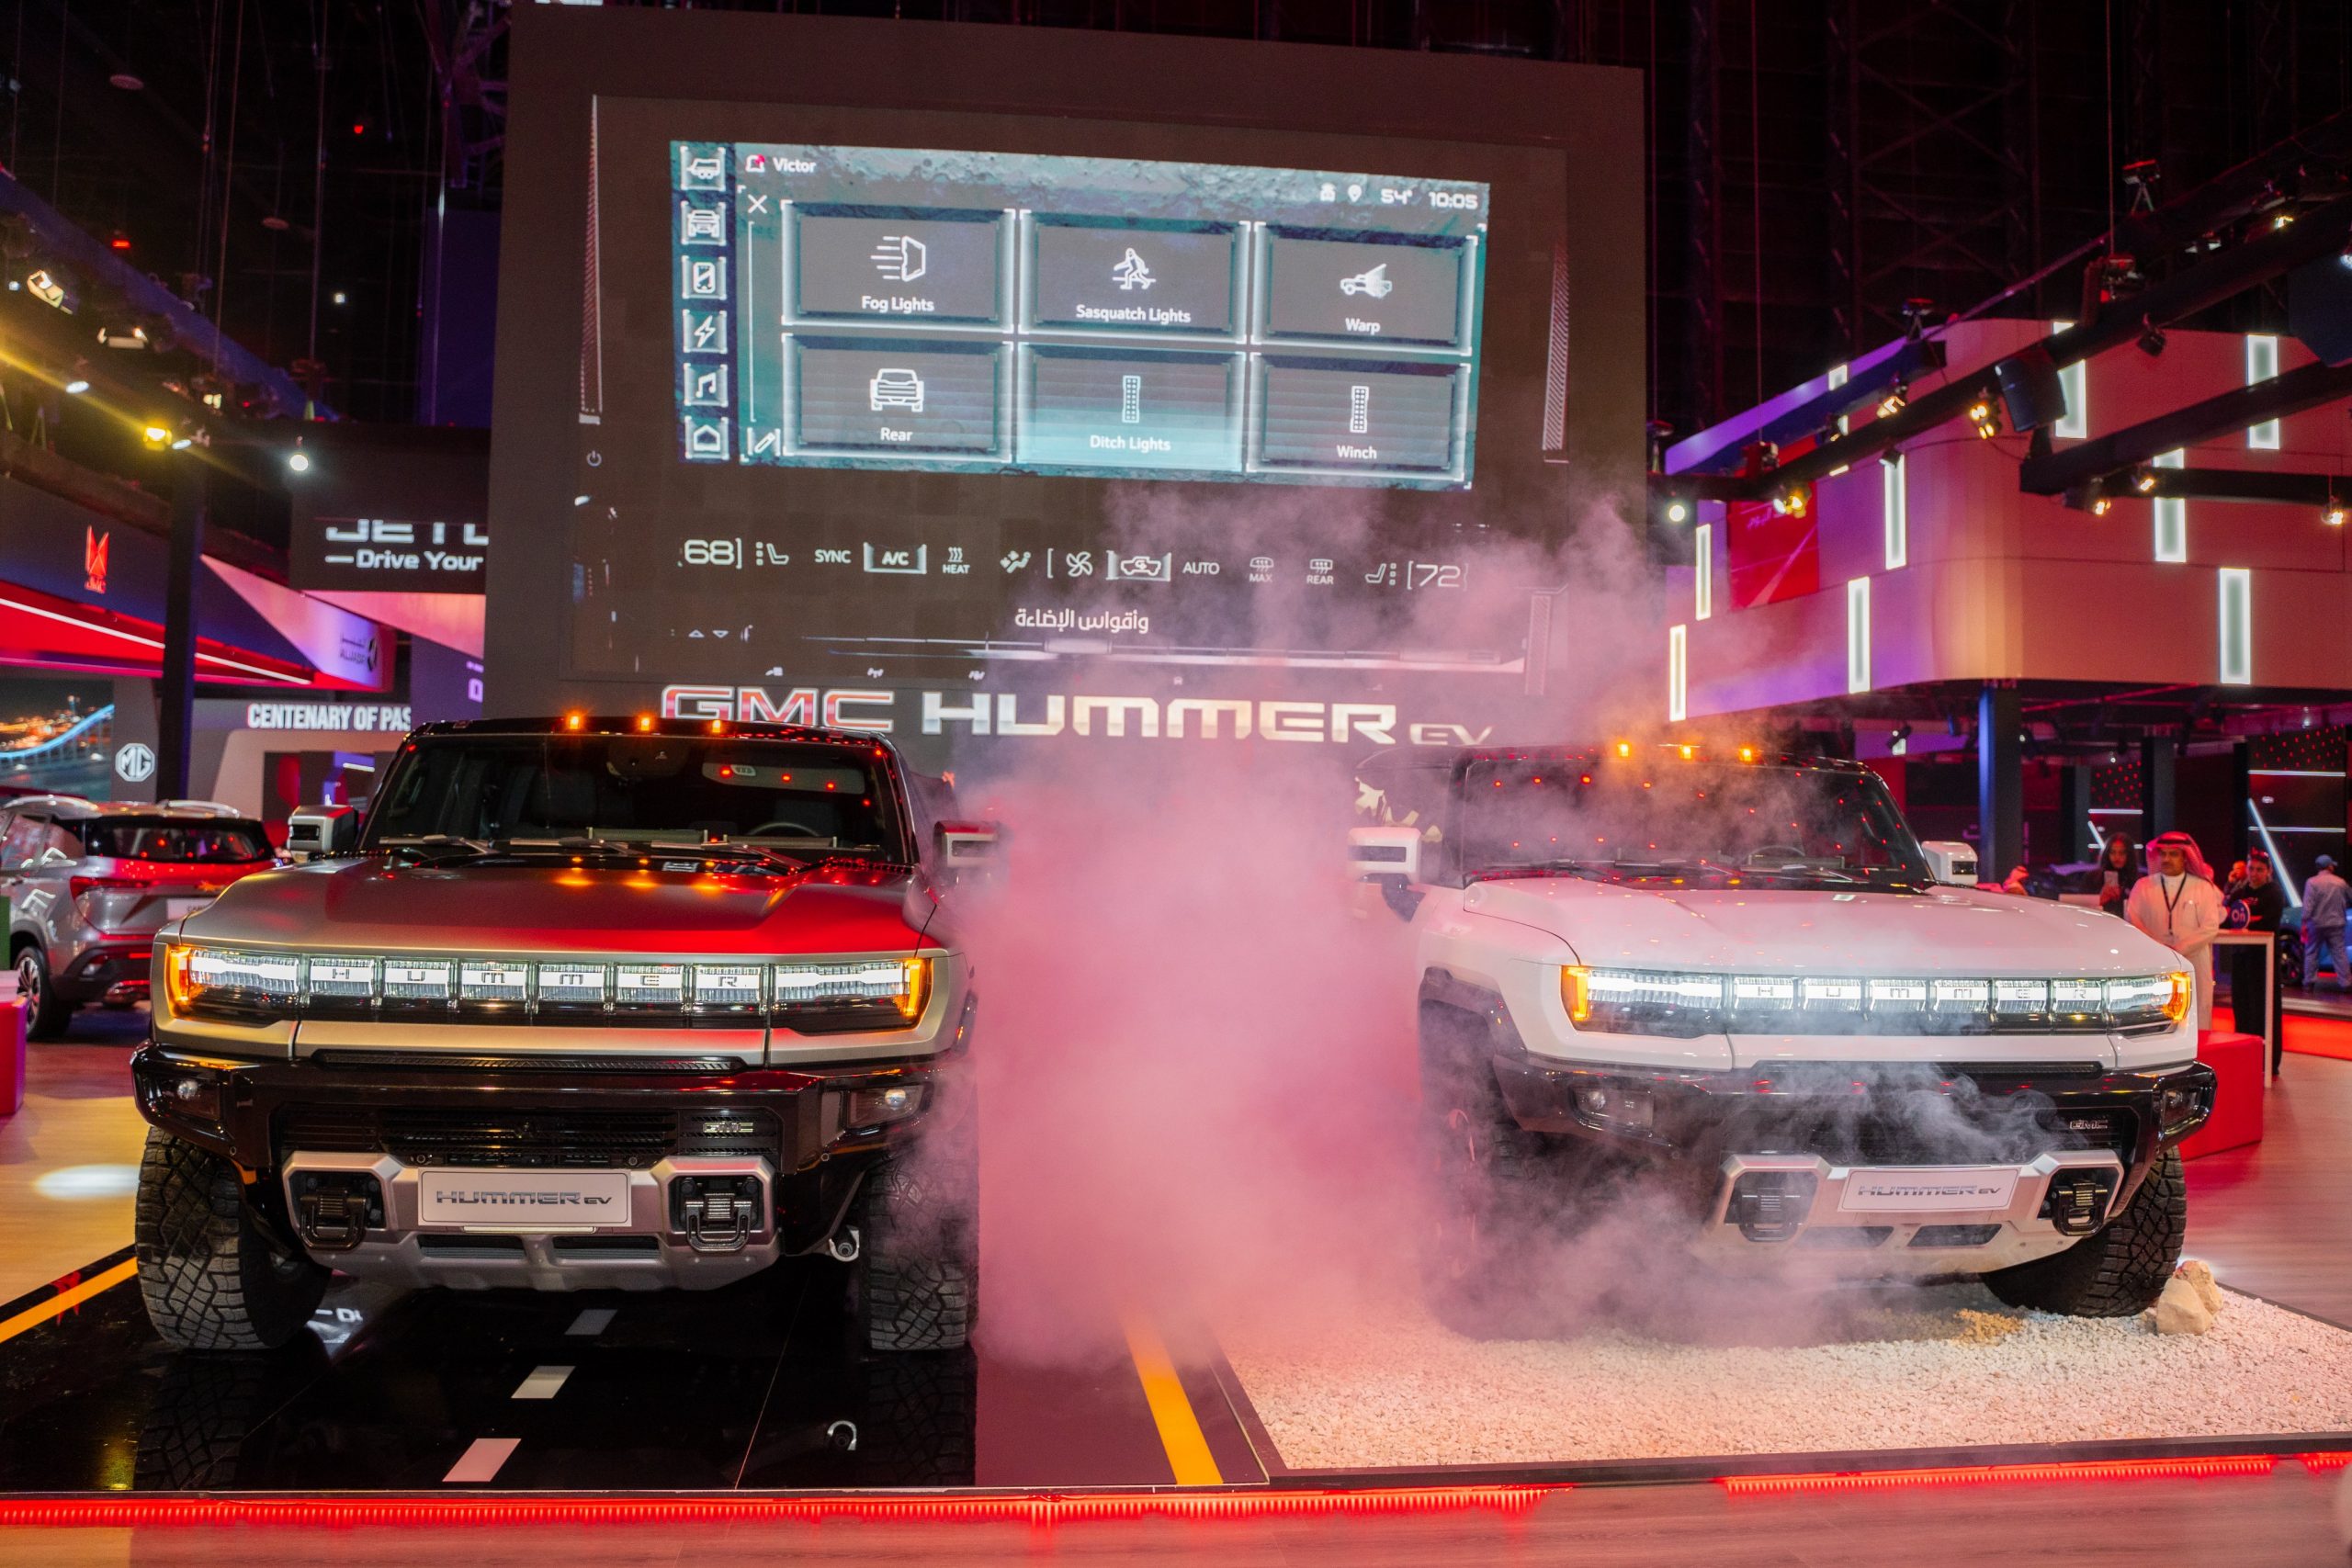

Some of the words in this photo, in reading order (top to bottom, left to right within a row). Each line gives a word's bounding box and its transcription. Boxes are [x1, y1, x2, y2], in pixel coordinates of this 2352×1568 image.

[773, 157, 817, 174] Victor
[1428, 190, 1478, 210] 10:05
[861, 295, 888, 313] Fog
[891, 296, 935, 313] Lights
[1075, 303, 1147, 322] Sasquatch
[1148, 306, 1192, 324] Lights
[1345, 318, 1381, 336] Warp
[880, 426, 913, 443] Rear
[1089, 434, 1125, 450] Ditch
[1128, 435, 1171, 453] Lights
[1336, 445, 1377, 459] Winch
[356, 548, 420, 570] Drive
[424, 551, 484, 571] Your
[814, 548, 852, 564] SYNC
[881, 550, 910, 566] A/C
[942, 564, 970, 575] HEAT
[1182, 560, 1220, 576] AUTO
[1249, 572, 1273, 583] MAX
[1306, 574, 1334, 585] REAR
[1014, 608, 1075, 632] الإضاءة
[1078, 609, 1149, 635] وأقواس
[247, 703, 353, 731] CENTENARY
[353, 705, 379, 731] OF
[661, 685, 894, 734] GMC
[921, 690, 1396, 745] HUMMER
[1410, 723, 1494, 746] EV
[119, 745, 153, 779] MG
[436, 1190, 582, 1205] HUMMER
[583, 1196, 613, 1205] EV
[1858, 1185, 1978, 1196] HUMMER
[1978, 1187, 2002, 1195] EV
